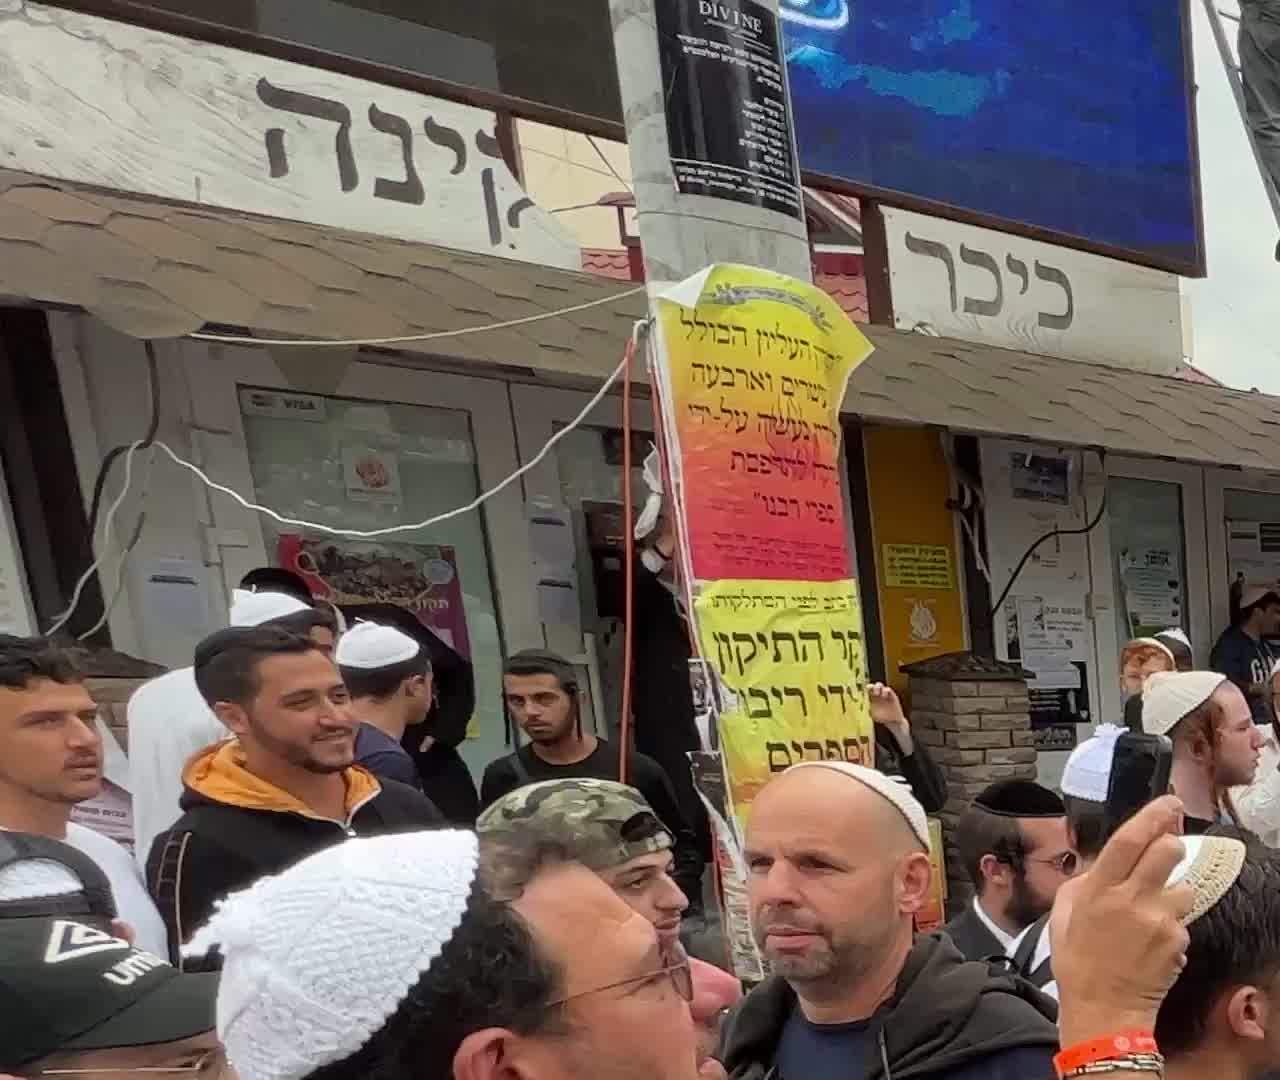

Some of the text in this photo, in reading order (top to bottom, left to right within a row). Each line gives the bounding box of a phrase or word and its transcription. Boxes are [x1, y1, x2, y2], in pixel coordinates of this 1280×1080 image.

[699, 1, 763, 33] DIVINE
[905, 231, 1073, 330] כיכר
[691, 362, 774, 393] וארבעה
[713, 630, 825, 677] התיקון
